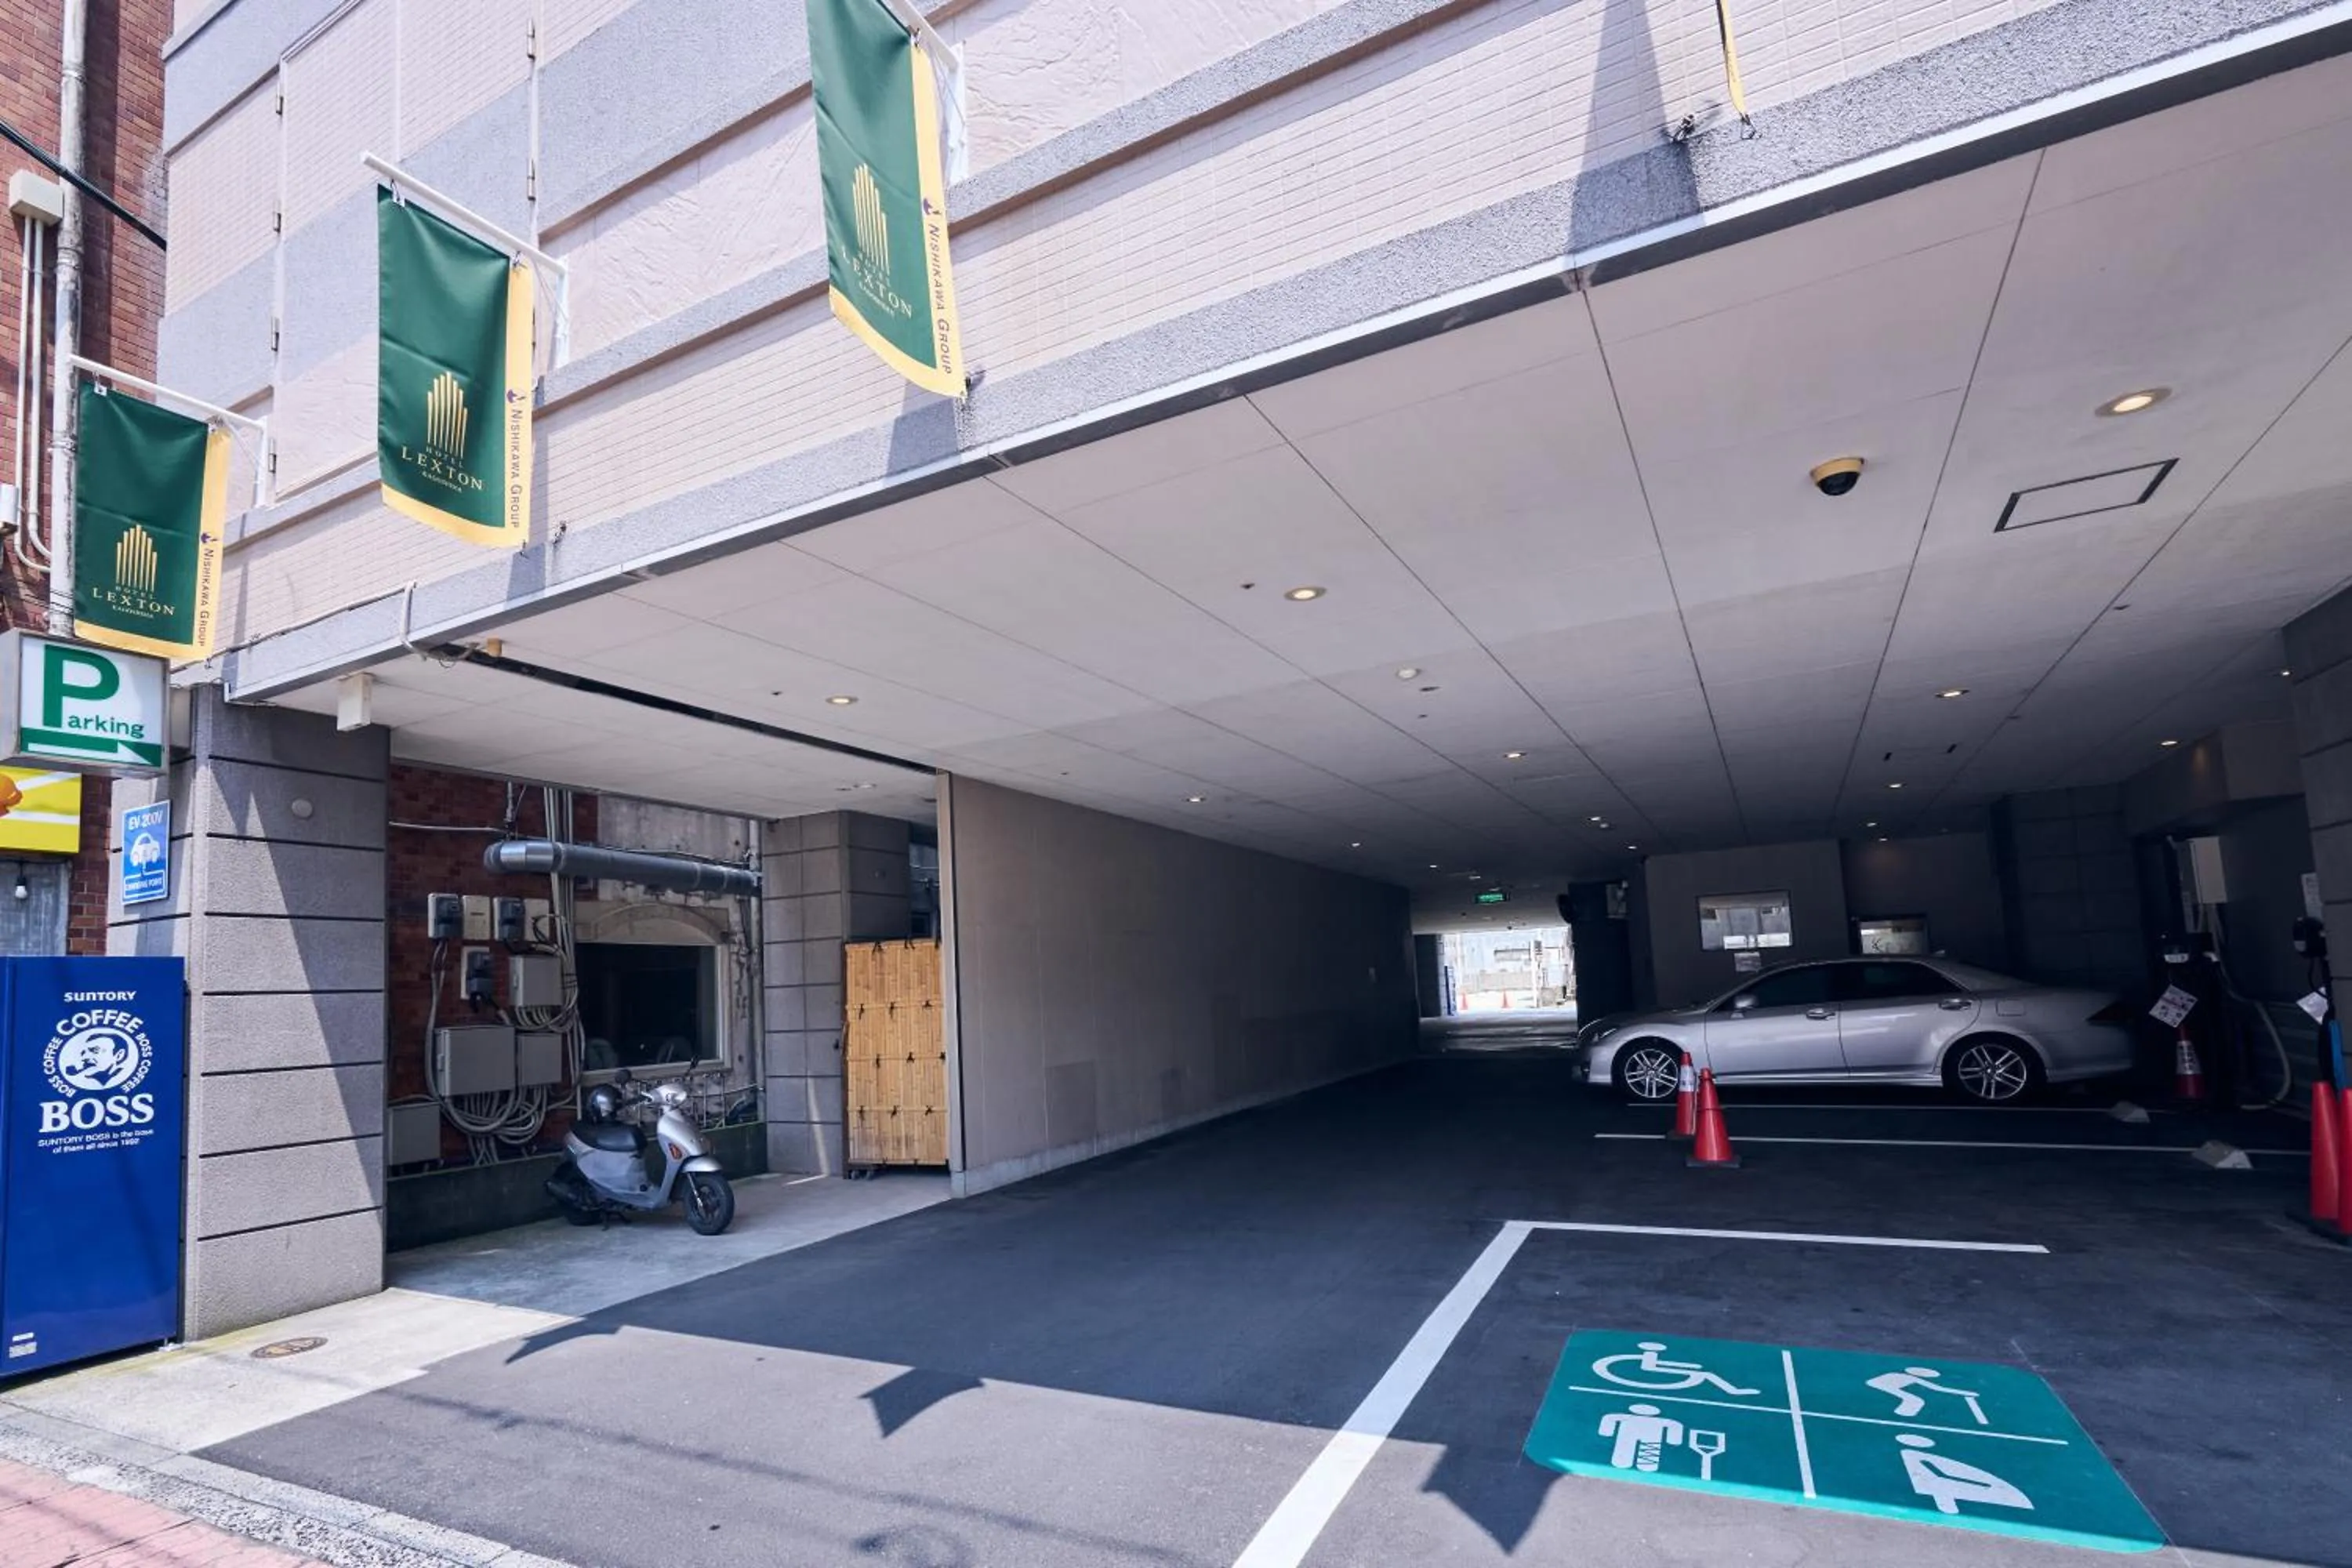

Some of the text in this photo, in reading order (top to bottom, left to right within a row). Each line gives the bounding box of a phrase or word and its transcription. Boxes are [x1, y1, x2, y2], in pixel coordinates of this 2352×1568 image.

[841, 245, 912, 318] LEXTON
[928, 223, 952, 374] NISHIKAWA GROUP
[401, 445, 483, 491] LEXTON
[510, 408, 523, 528] NISHIKAWA GROUP
[92, 587, 176, 615] LEXTON
[198, 548, 214, 647] NISHIKAWA GROUP
[56, 1009, 143, 1036] COFFEE
[43, 1036, 77, 1098] BOSS COFFEE
[121, 1033, 153, 1094] BOSS COFFEE
[38, 1093, 154, 1133] BOSS
